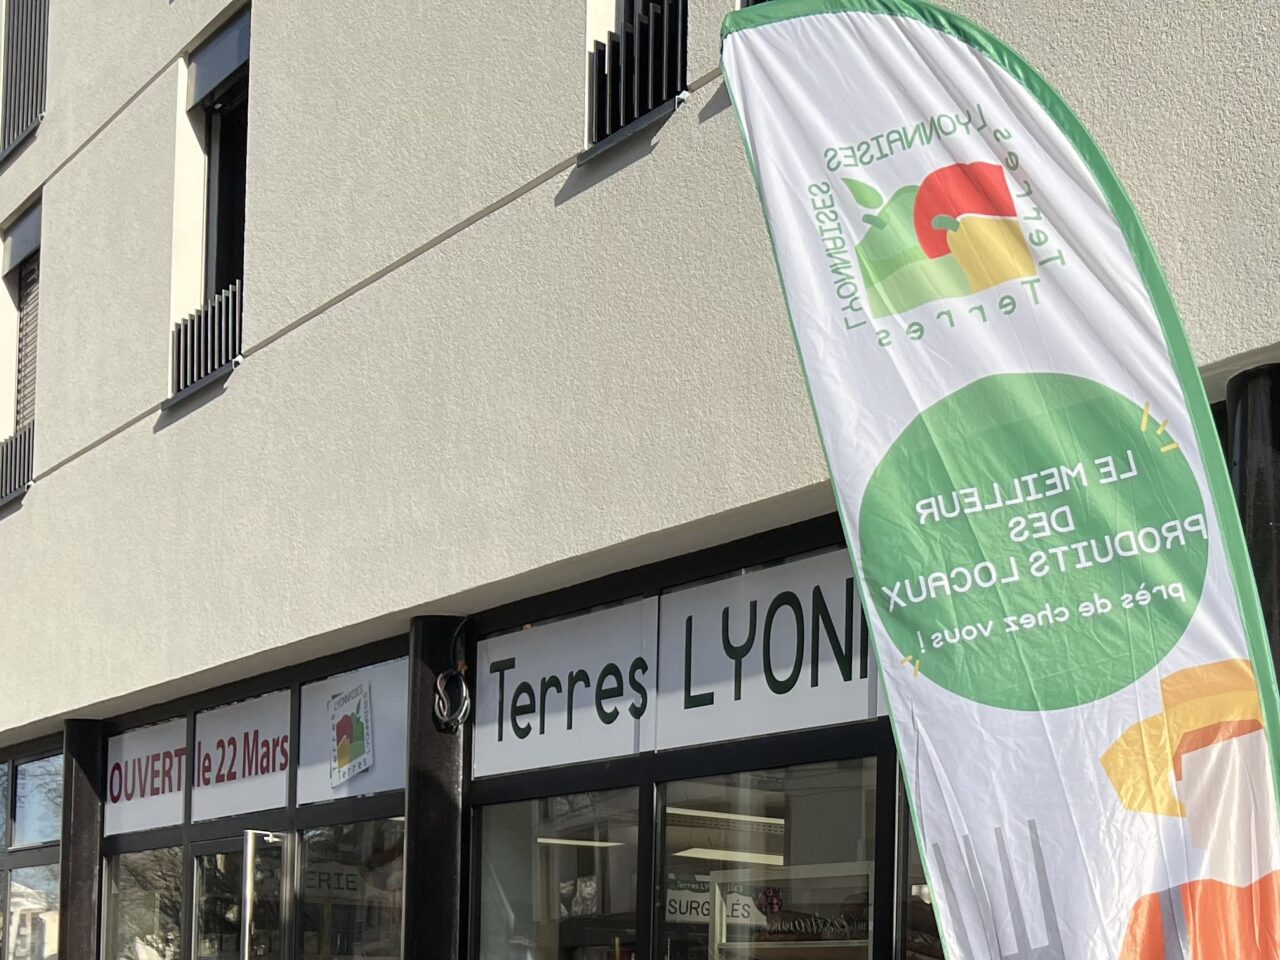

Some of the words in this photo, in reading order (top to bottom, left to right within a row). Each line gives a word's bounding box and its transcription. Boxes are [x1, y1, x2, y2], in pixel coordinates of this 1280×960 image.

[489, 656, 649, 742] Terres
[109, 747, 188, 803] OUVERT
[197, 741, 212, 787] le
[215, 736, 237, 784] 22
[242, 730, 288, 778] Mars
